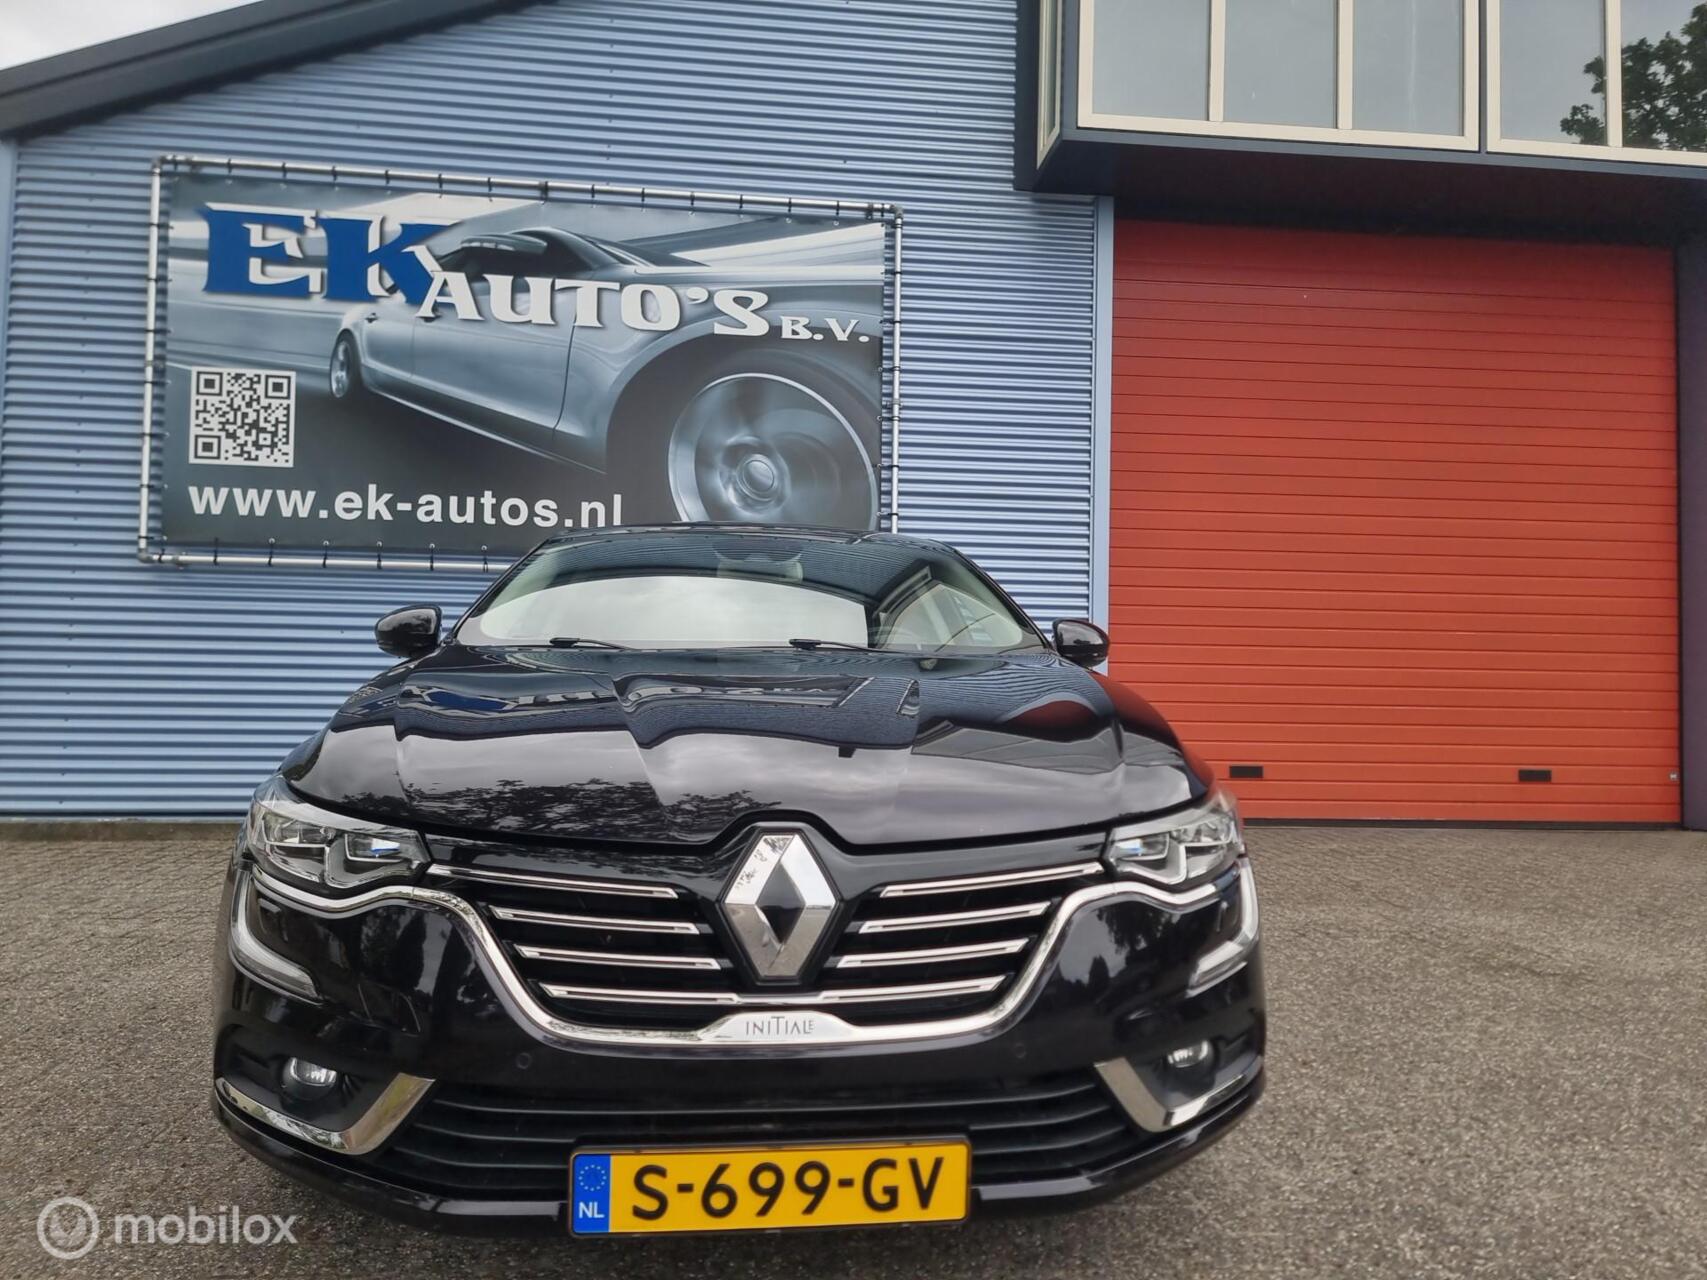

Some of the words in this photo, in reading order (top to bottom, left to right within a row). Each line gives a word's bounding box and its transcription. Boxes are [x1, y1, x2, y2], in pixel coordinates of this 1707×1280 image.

[204, 202, 457, 307] EK
[780, 314, 871, 343] B.V.
[188, 484, 623, 528] www.ek-autos.nl
[745, 1016, 815, 1036] INITIALE
[578, 1202, 605, 1218] NL
[632, 1157, 944, 1220] S-699-GV
